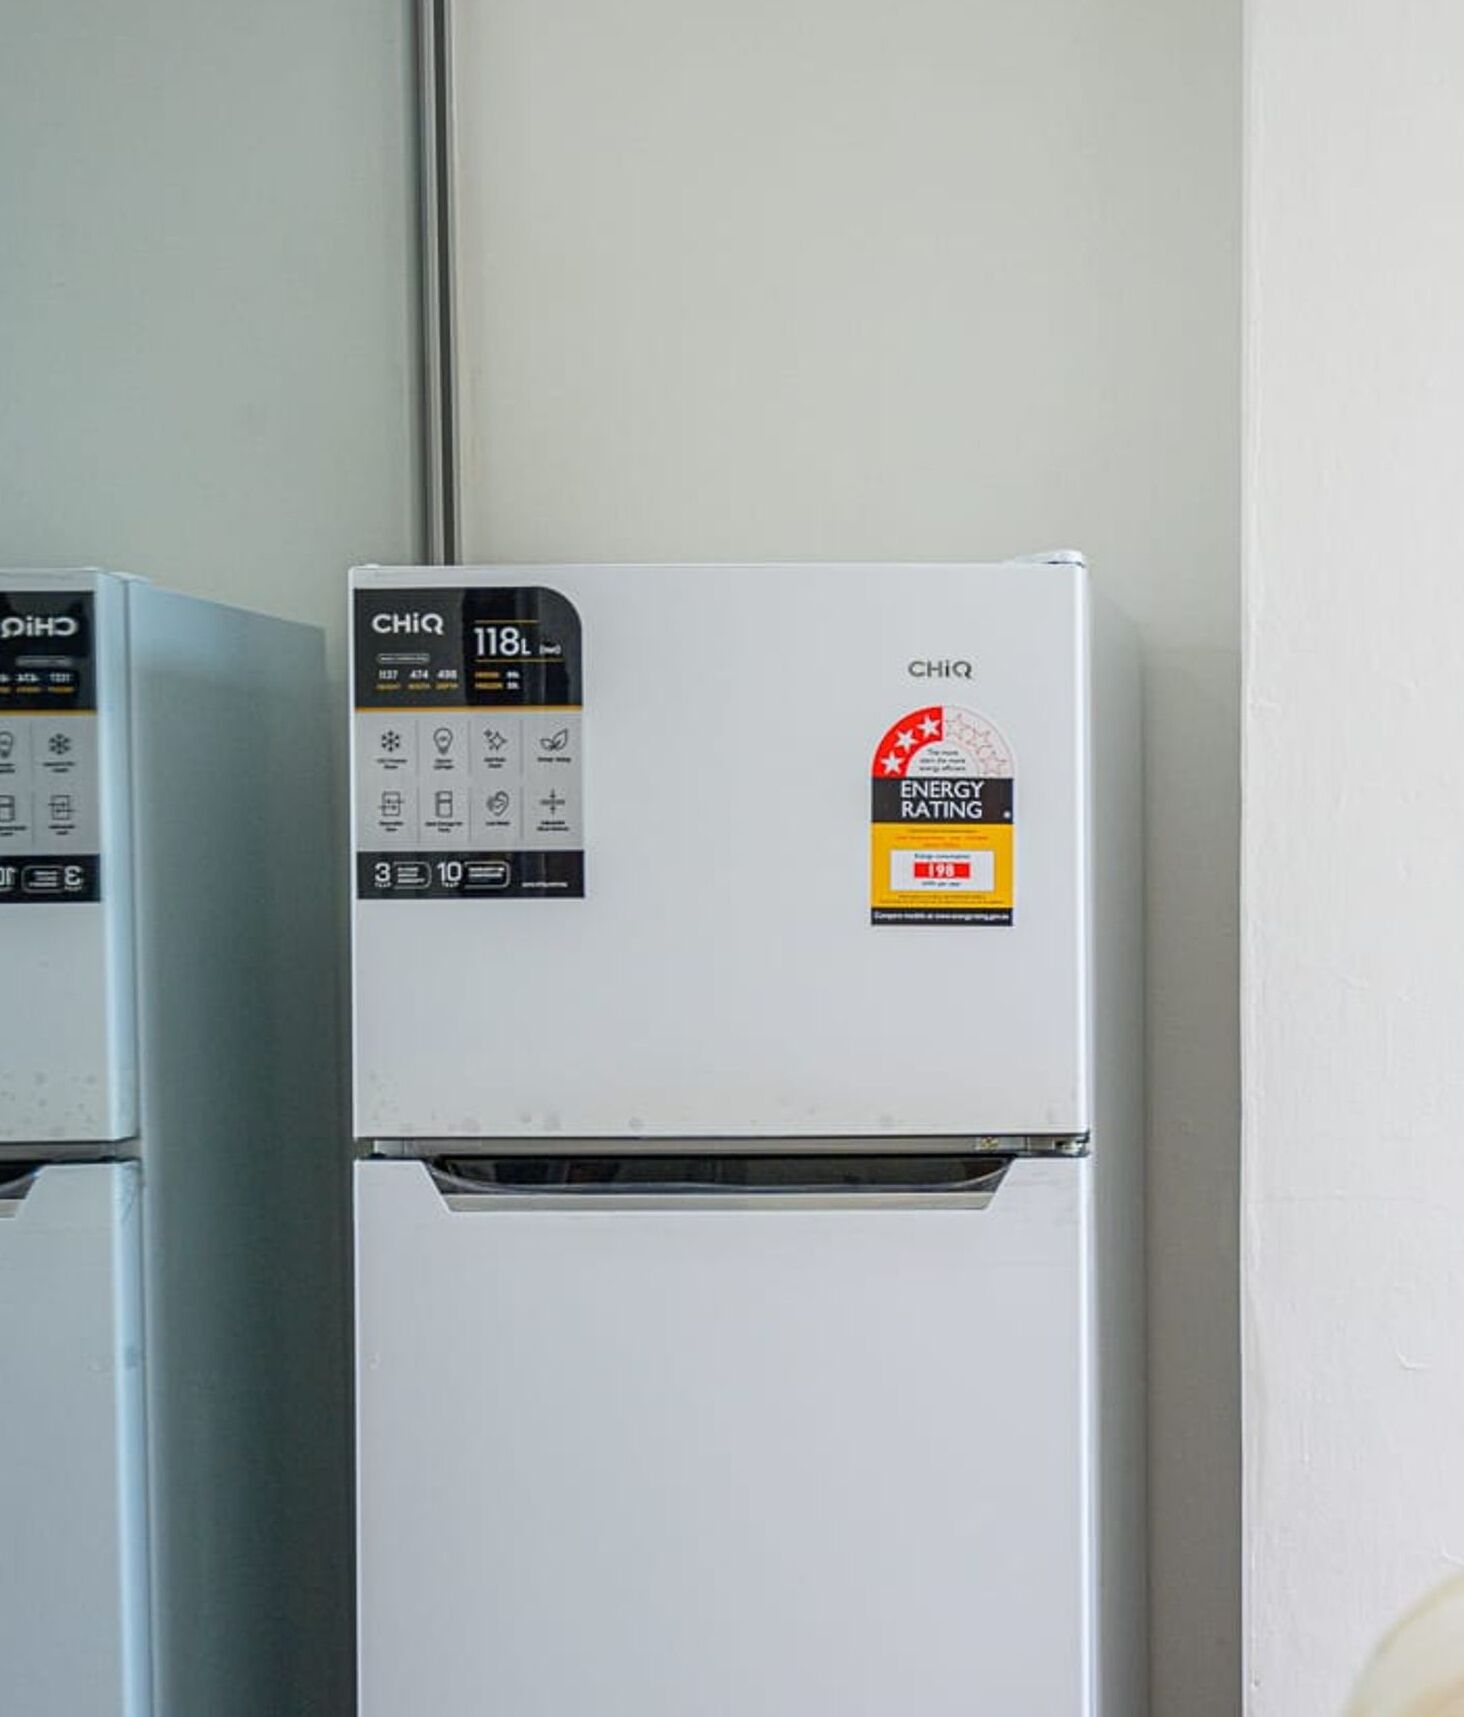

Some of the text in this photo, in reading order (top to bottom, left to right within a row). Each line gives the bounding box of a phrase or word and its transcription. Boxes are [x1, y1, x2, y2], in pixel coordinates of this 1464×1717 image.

[371, 612, 444, 635] CHiQ
[907, 659, 972, 679] CHiQ
[901, 780, 984, 799] ENERGY
[901, 800, 983, 819] RATING
[374, 861, 391, 882] 3
[436, 861, 462, 882] 10
